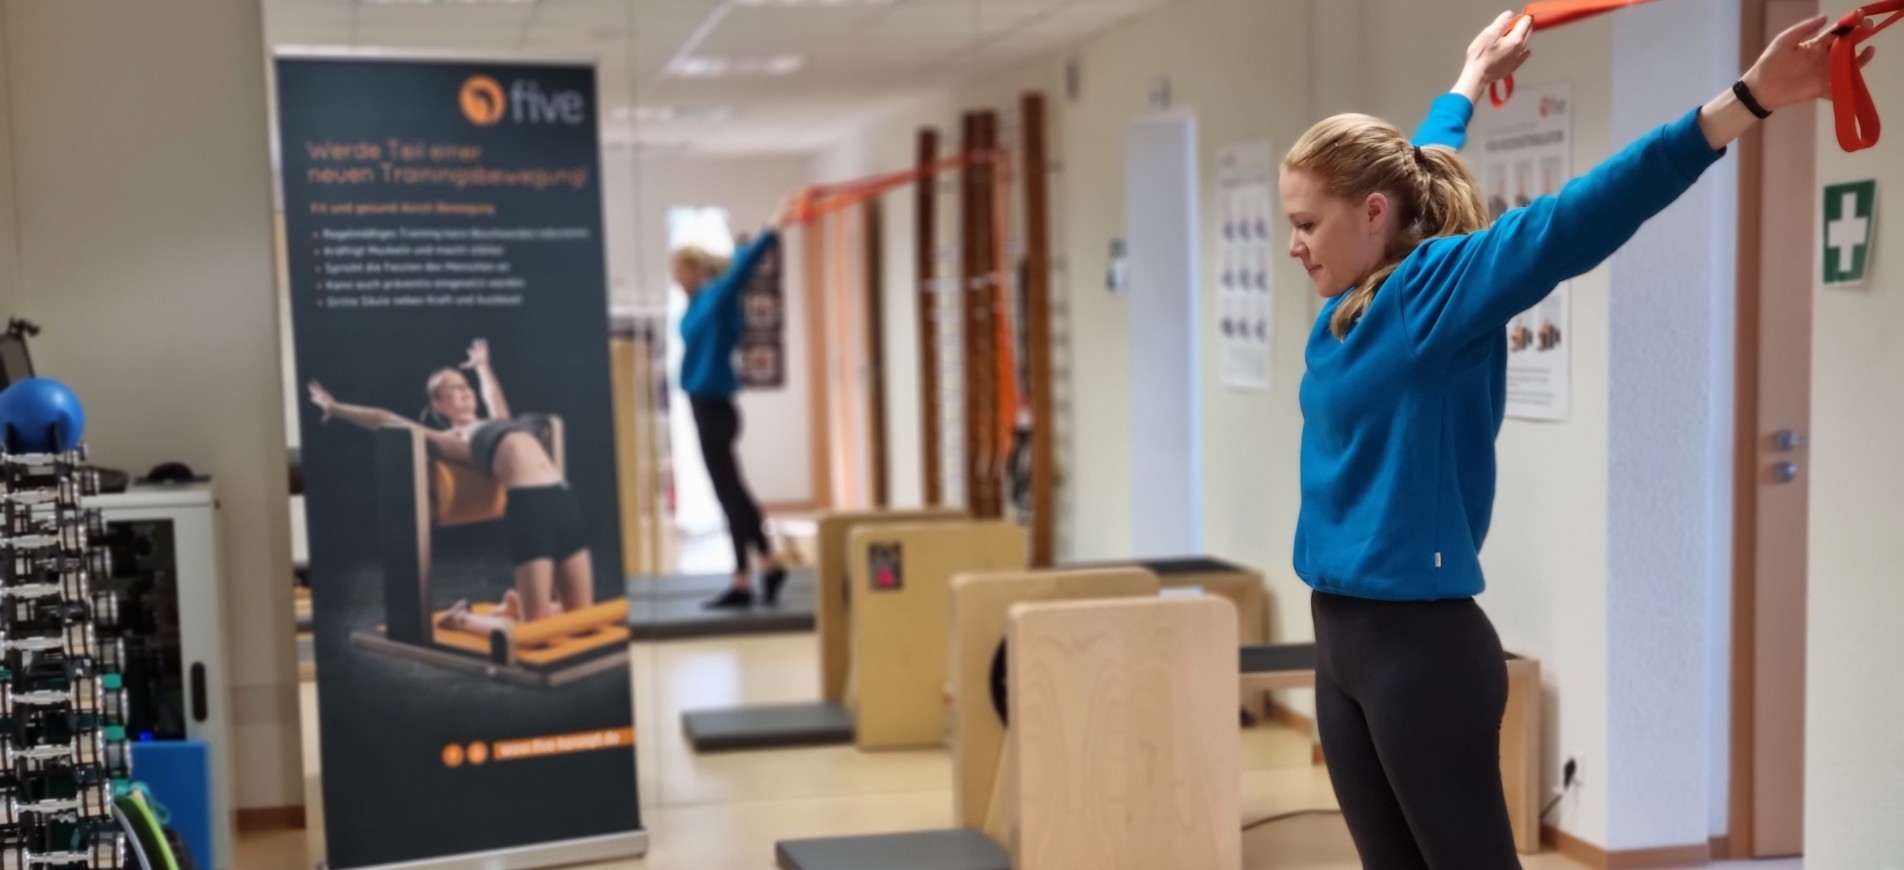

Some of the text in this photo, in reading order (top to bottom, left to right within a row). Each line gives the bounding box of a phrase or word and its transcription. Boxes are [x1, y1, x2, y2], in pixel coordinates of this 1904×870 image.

[510, 78, 585, 125] five
[305, 138, 482, 160] Werde Teil einer
[306, 165, 375, 184] neuen
[330, 202, 352, 214] und
